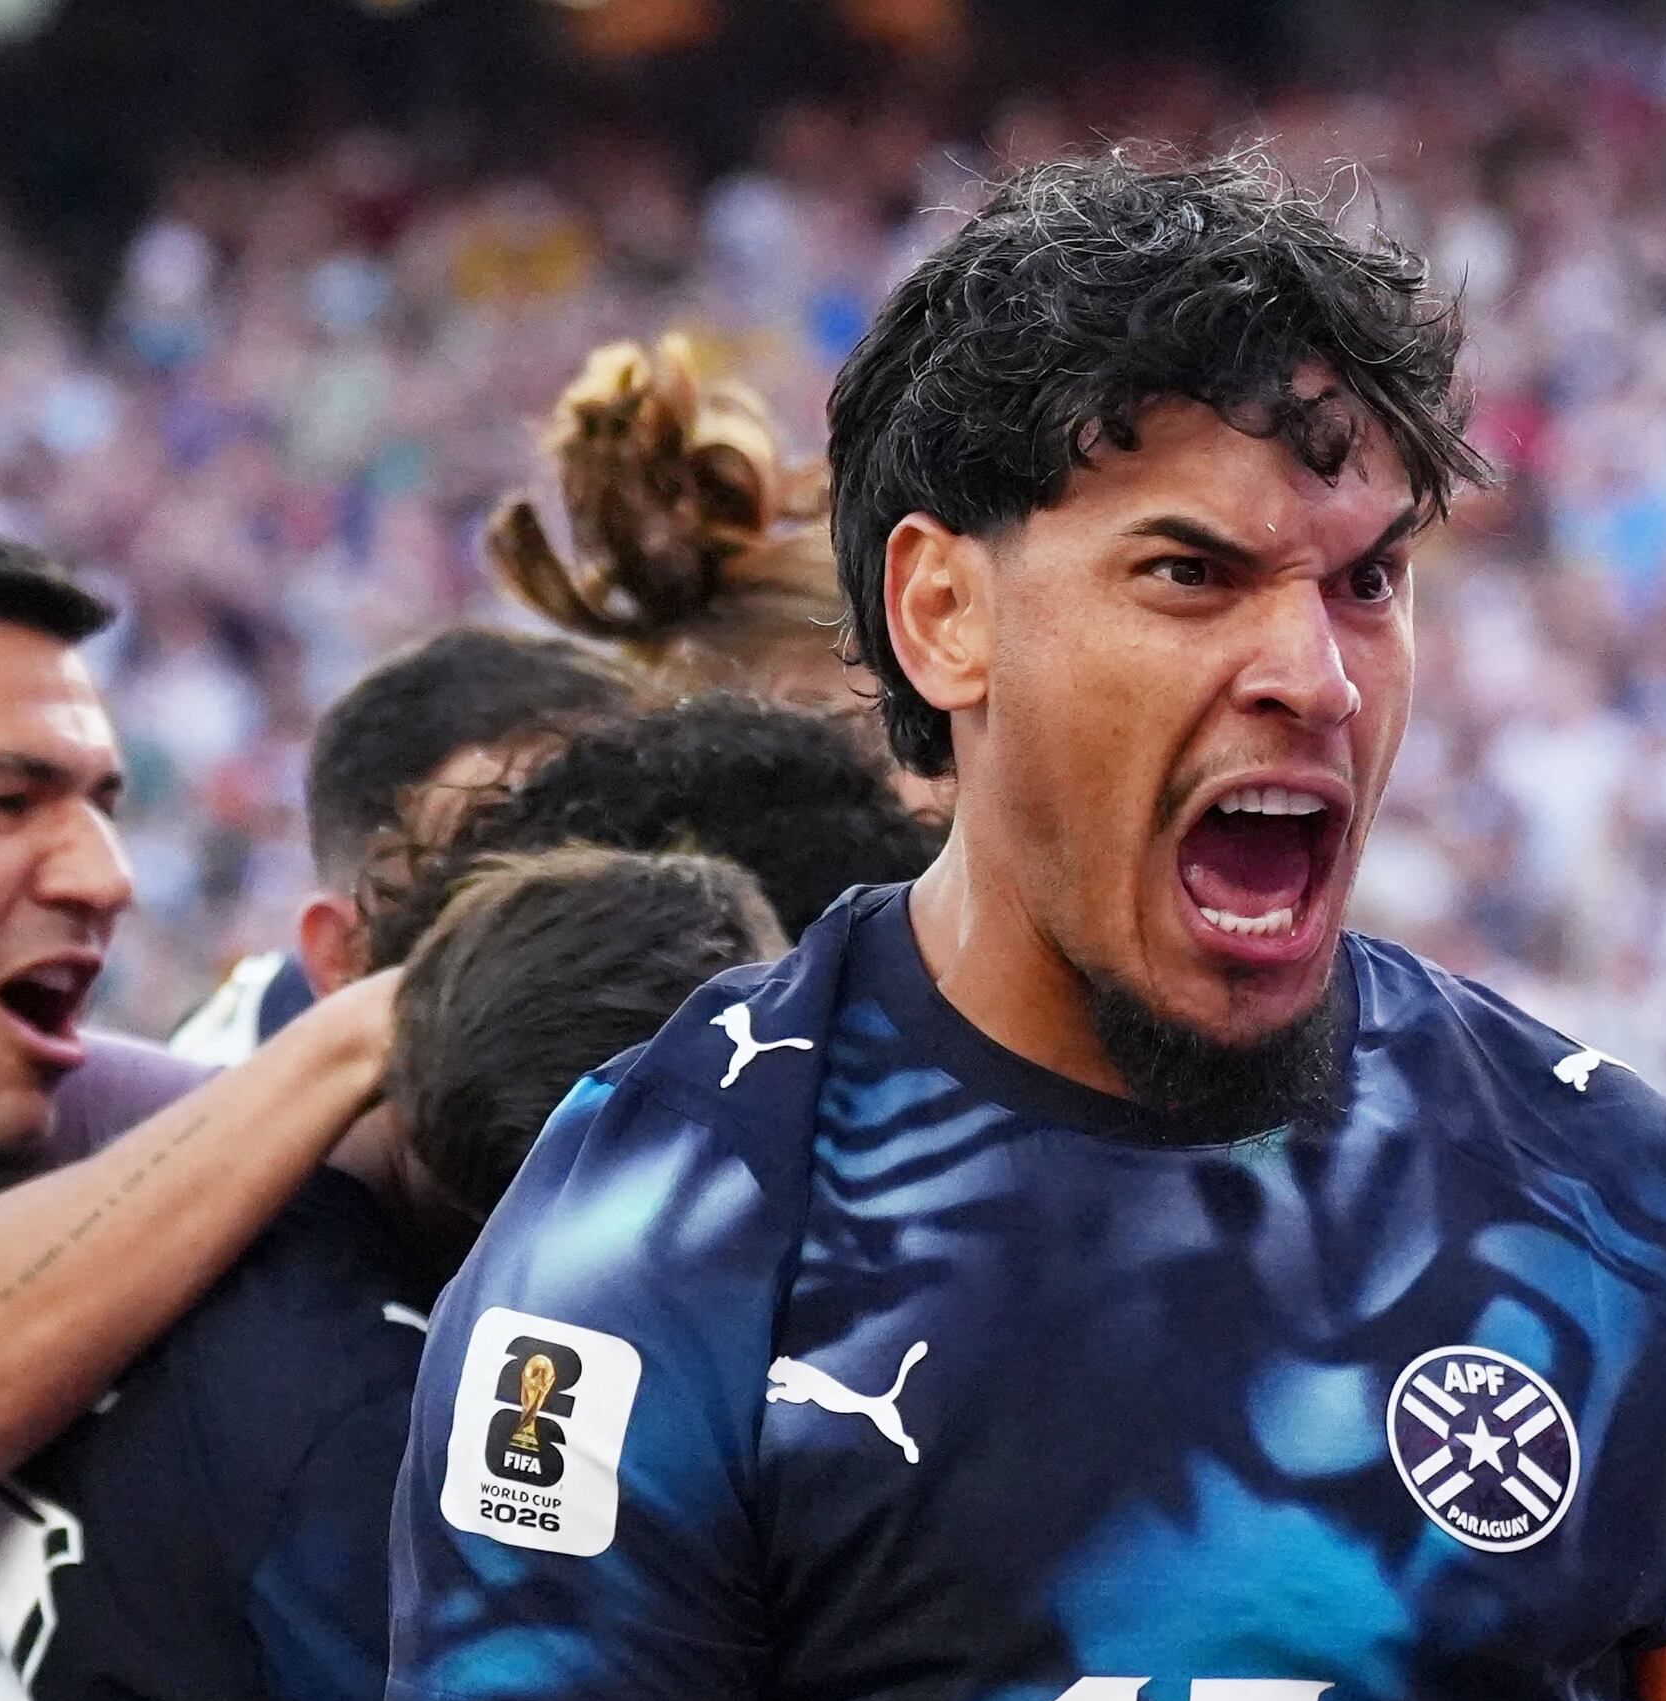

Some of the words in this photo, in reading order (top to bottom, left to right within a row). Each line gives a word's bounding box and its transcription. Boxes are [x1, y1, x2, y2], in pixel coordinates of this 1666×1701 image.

[1443, 1361, 1505, 1396] APF
[503, 1451, 542, 1476] FIFA
[480, 1482, 530, 1504] WORLD
[532, 1494, 562, 1510] CUP
[480, 1499, 561, 1533] 2026
[1446, 1504, 1530, 1538] PARAGUAY
